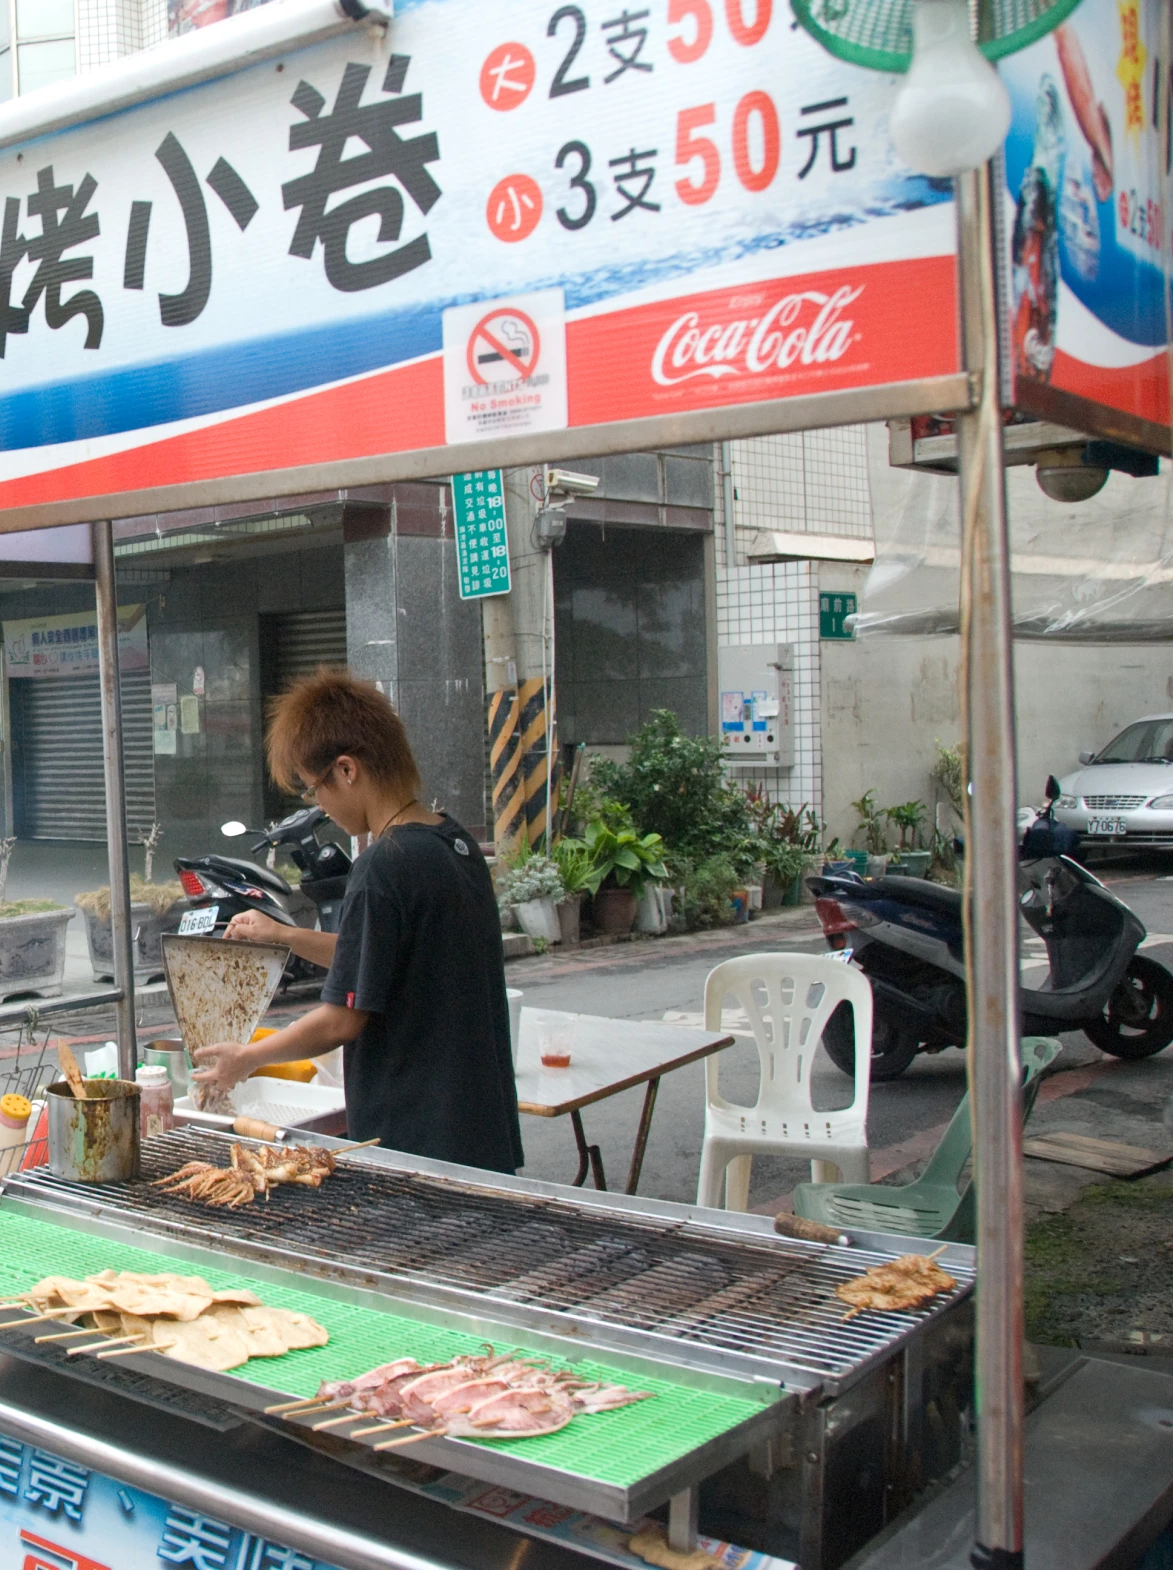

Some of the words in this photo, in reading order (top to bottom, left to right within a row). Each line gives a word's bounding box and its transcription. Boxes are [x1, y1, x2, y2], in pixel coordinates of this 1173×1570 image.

[554, 89, 857, 231] 3支50元
[651, 284, 867, 386] Coca-Cola
[470, 403, 486, 413] No
[490, 394, 542, 410] Smoking
